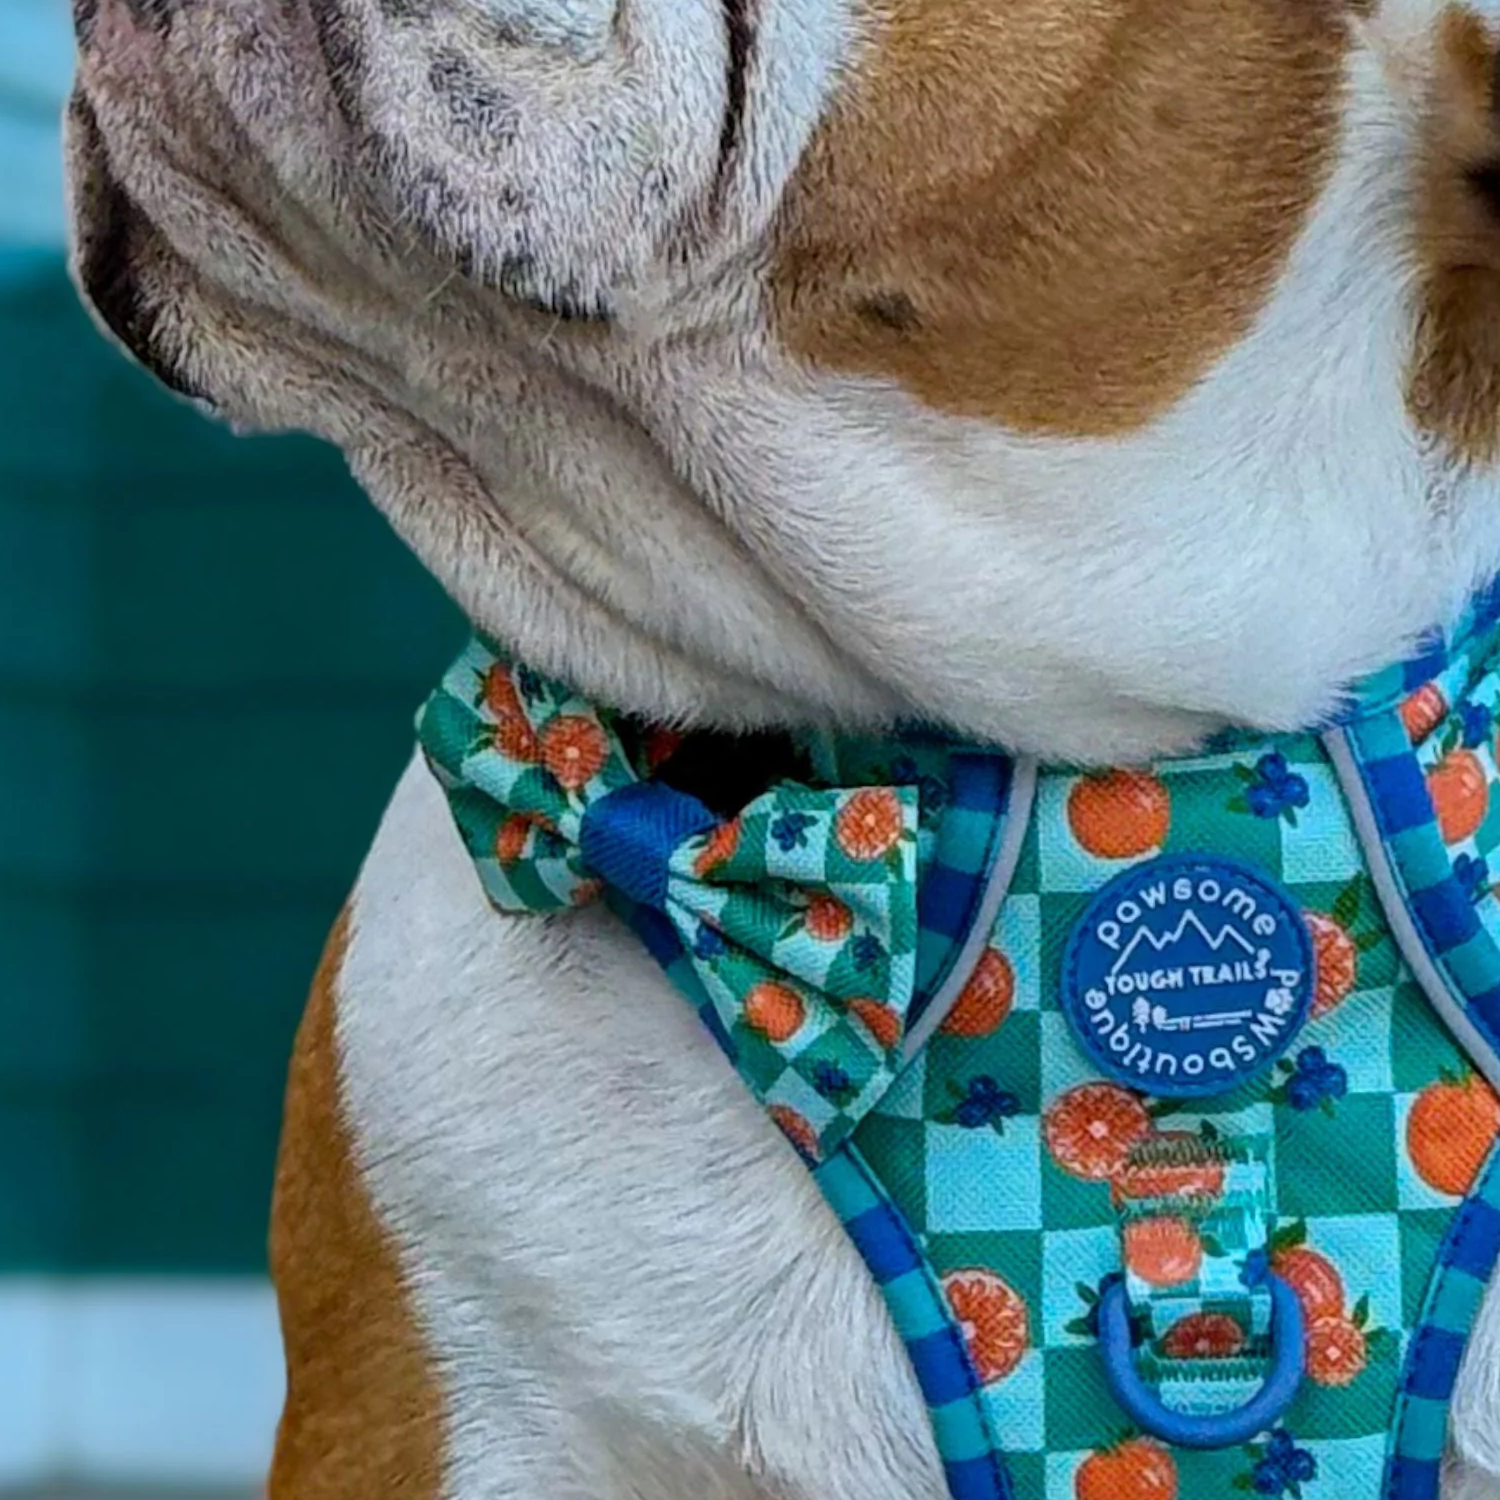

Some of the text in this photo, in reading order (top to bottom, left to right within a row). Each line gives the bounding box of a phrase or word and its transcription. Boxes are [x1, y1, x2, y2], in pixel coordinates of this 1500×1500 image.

[1096, 877, 1277, 950] pawsome
[1104, 959, 1268, 996] TOUGH TRAILS
